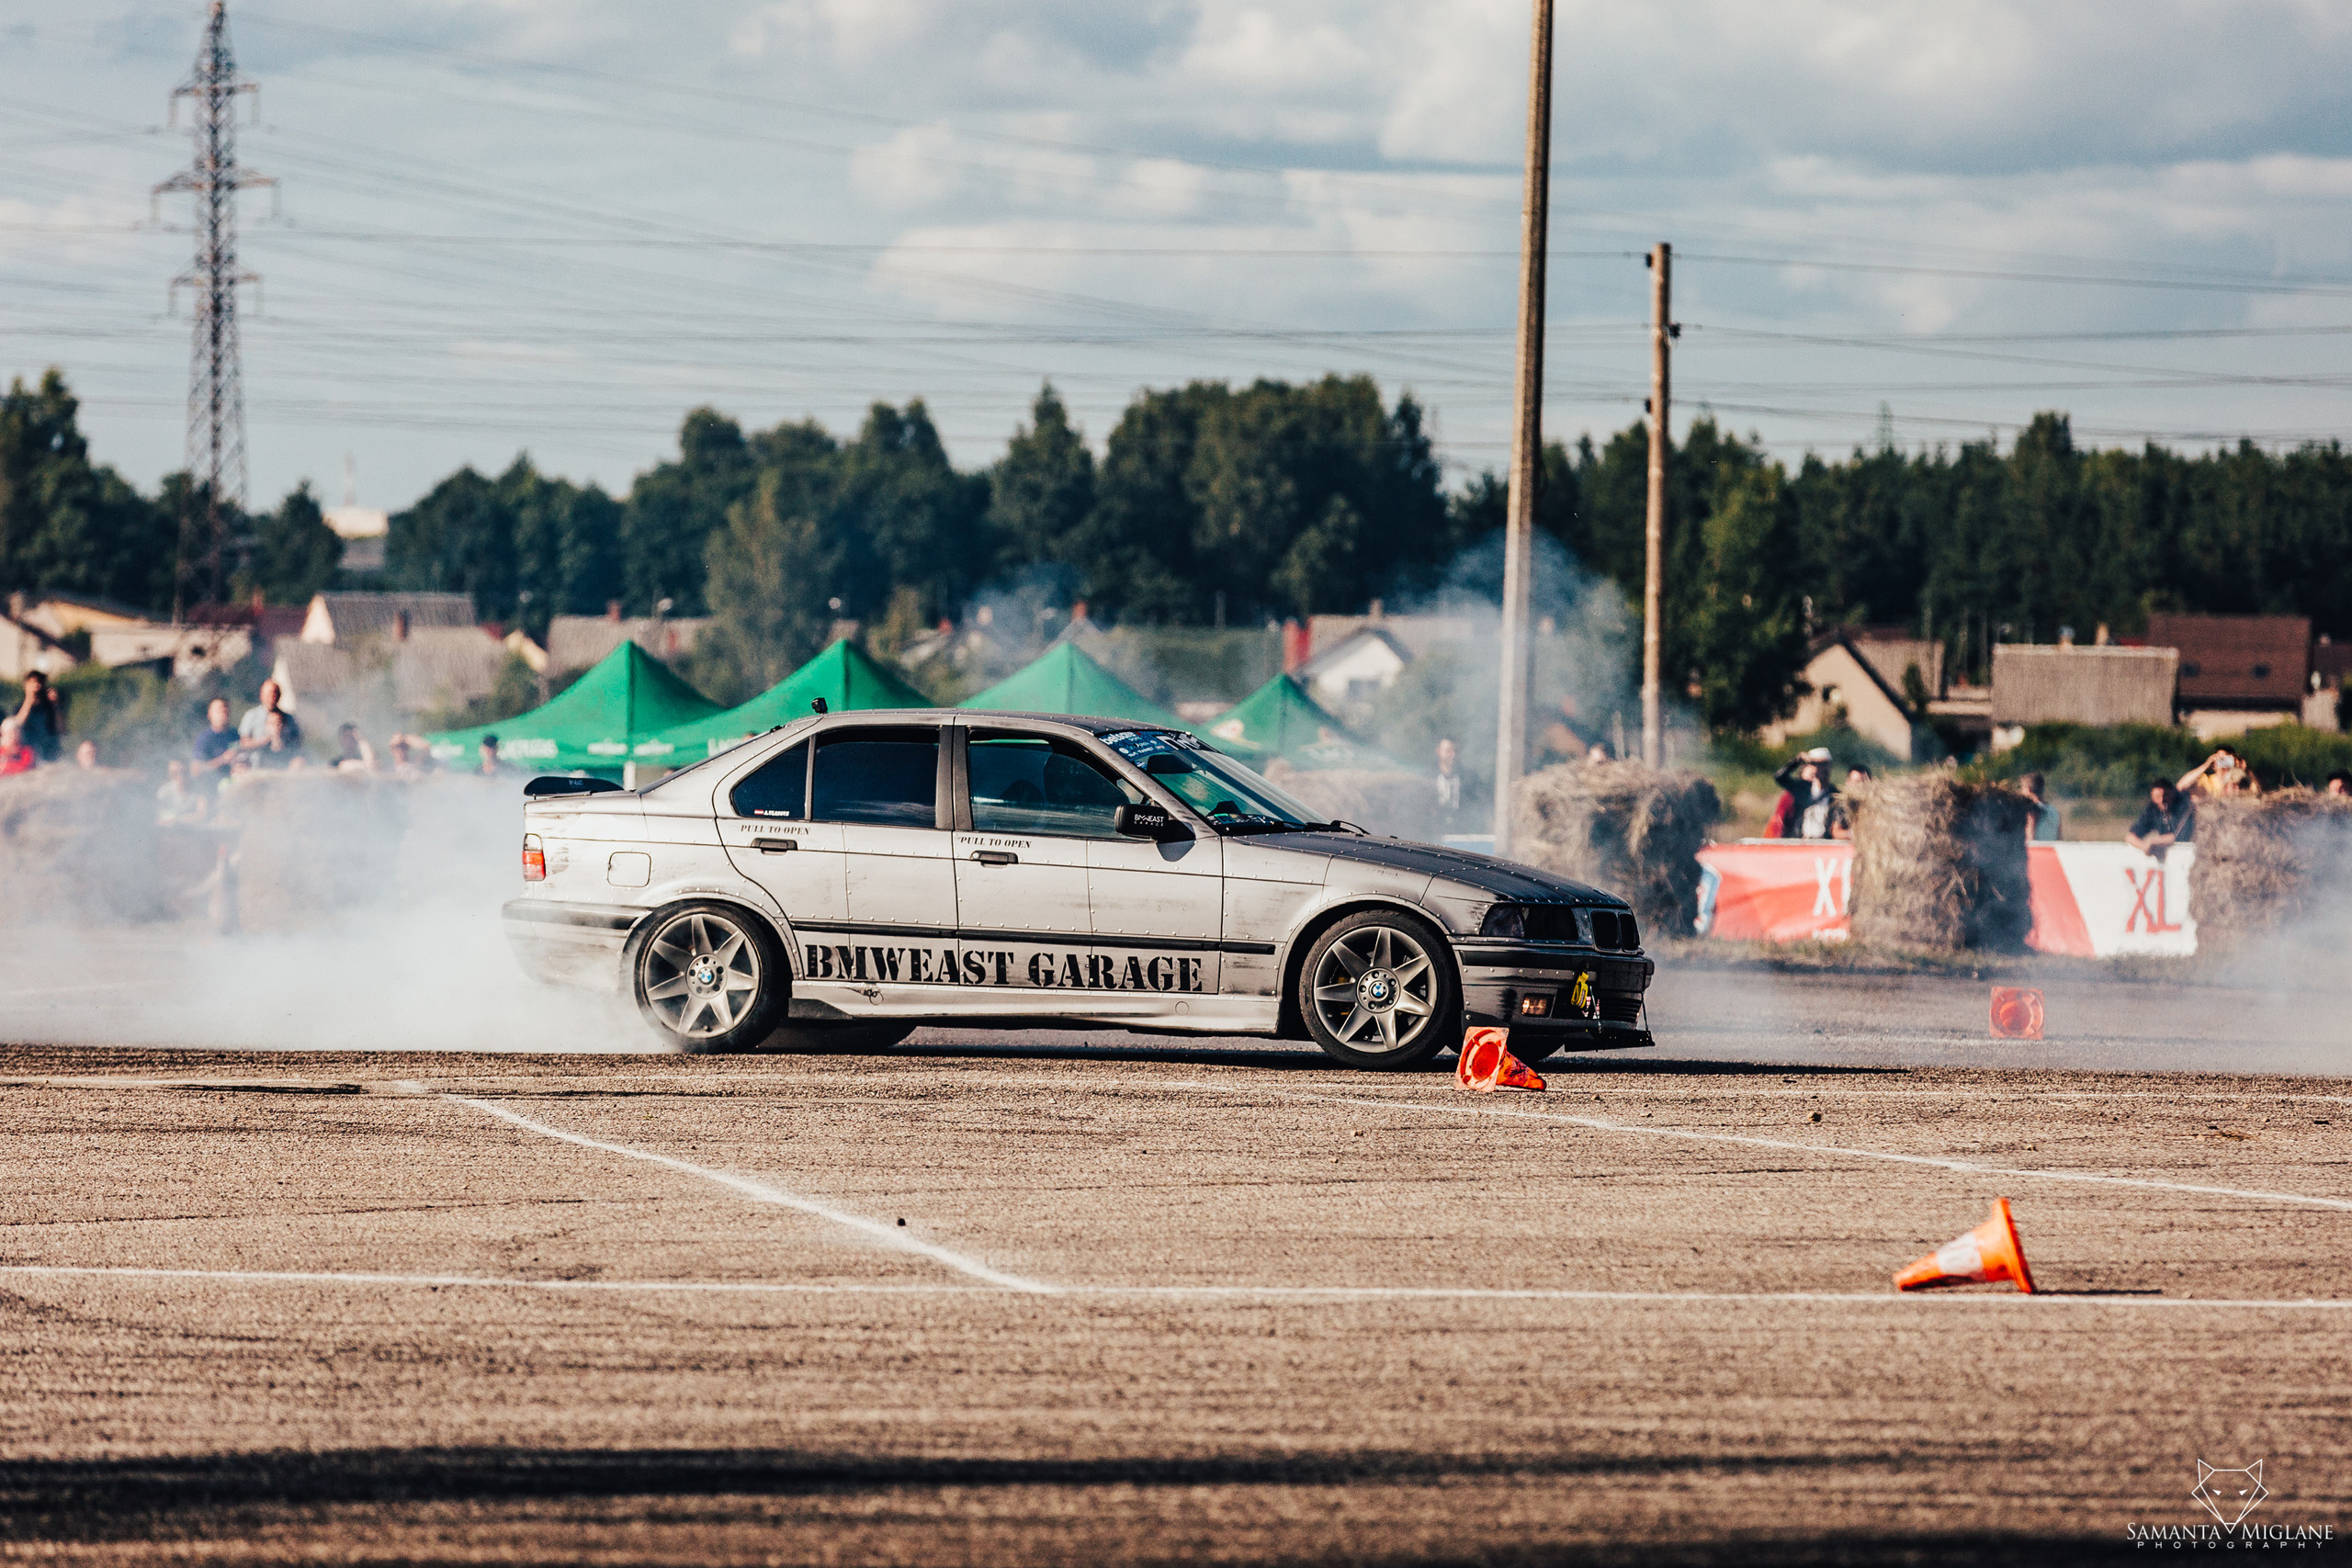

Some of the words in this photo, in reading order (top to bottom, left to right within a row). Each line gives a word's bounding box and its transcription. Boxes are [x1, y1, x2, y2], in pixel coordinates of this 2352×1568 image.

[741, 825, 764, 833] PULL
[768, 826, 781, 834] TO
[784, 827, 810, 835] OPEN
[960, 836, 985, 845] PULL
[989, 838, 1001, 846] TO
[1004, 839, 1031, 849] OPEN
[2125, 868, 2182, 933] XL
[805, 944, 1014, 985] BMWEAST
[1028, 953, 1203, 991] GARAGE
